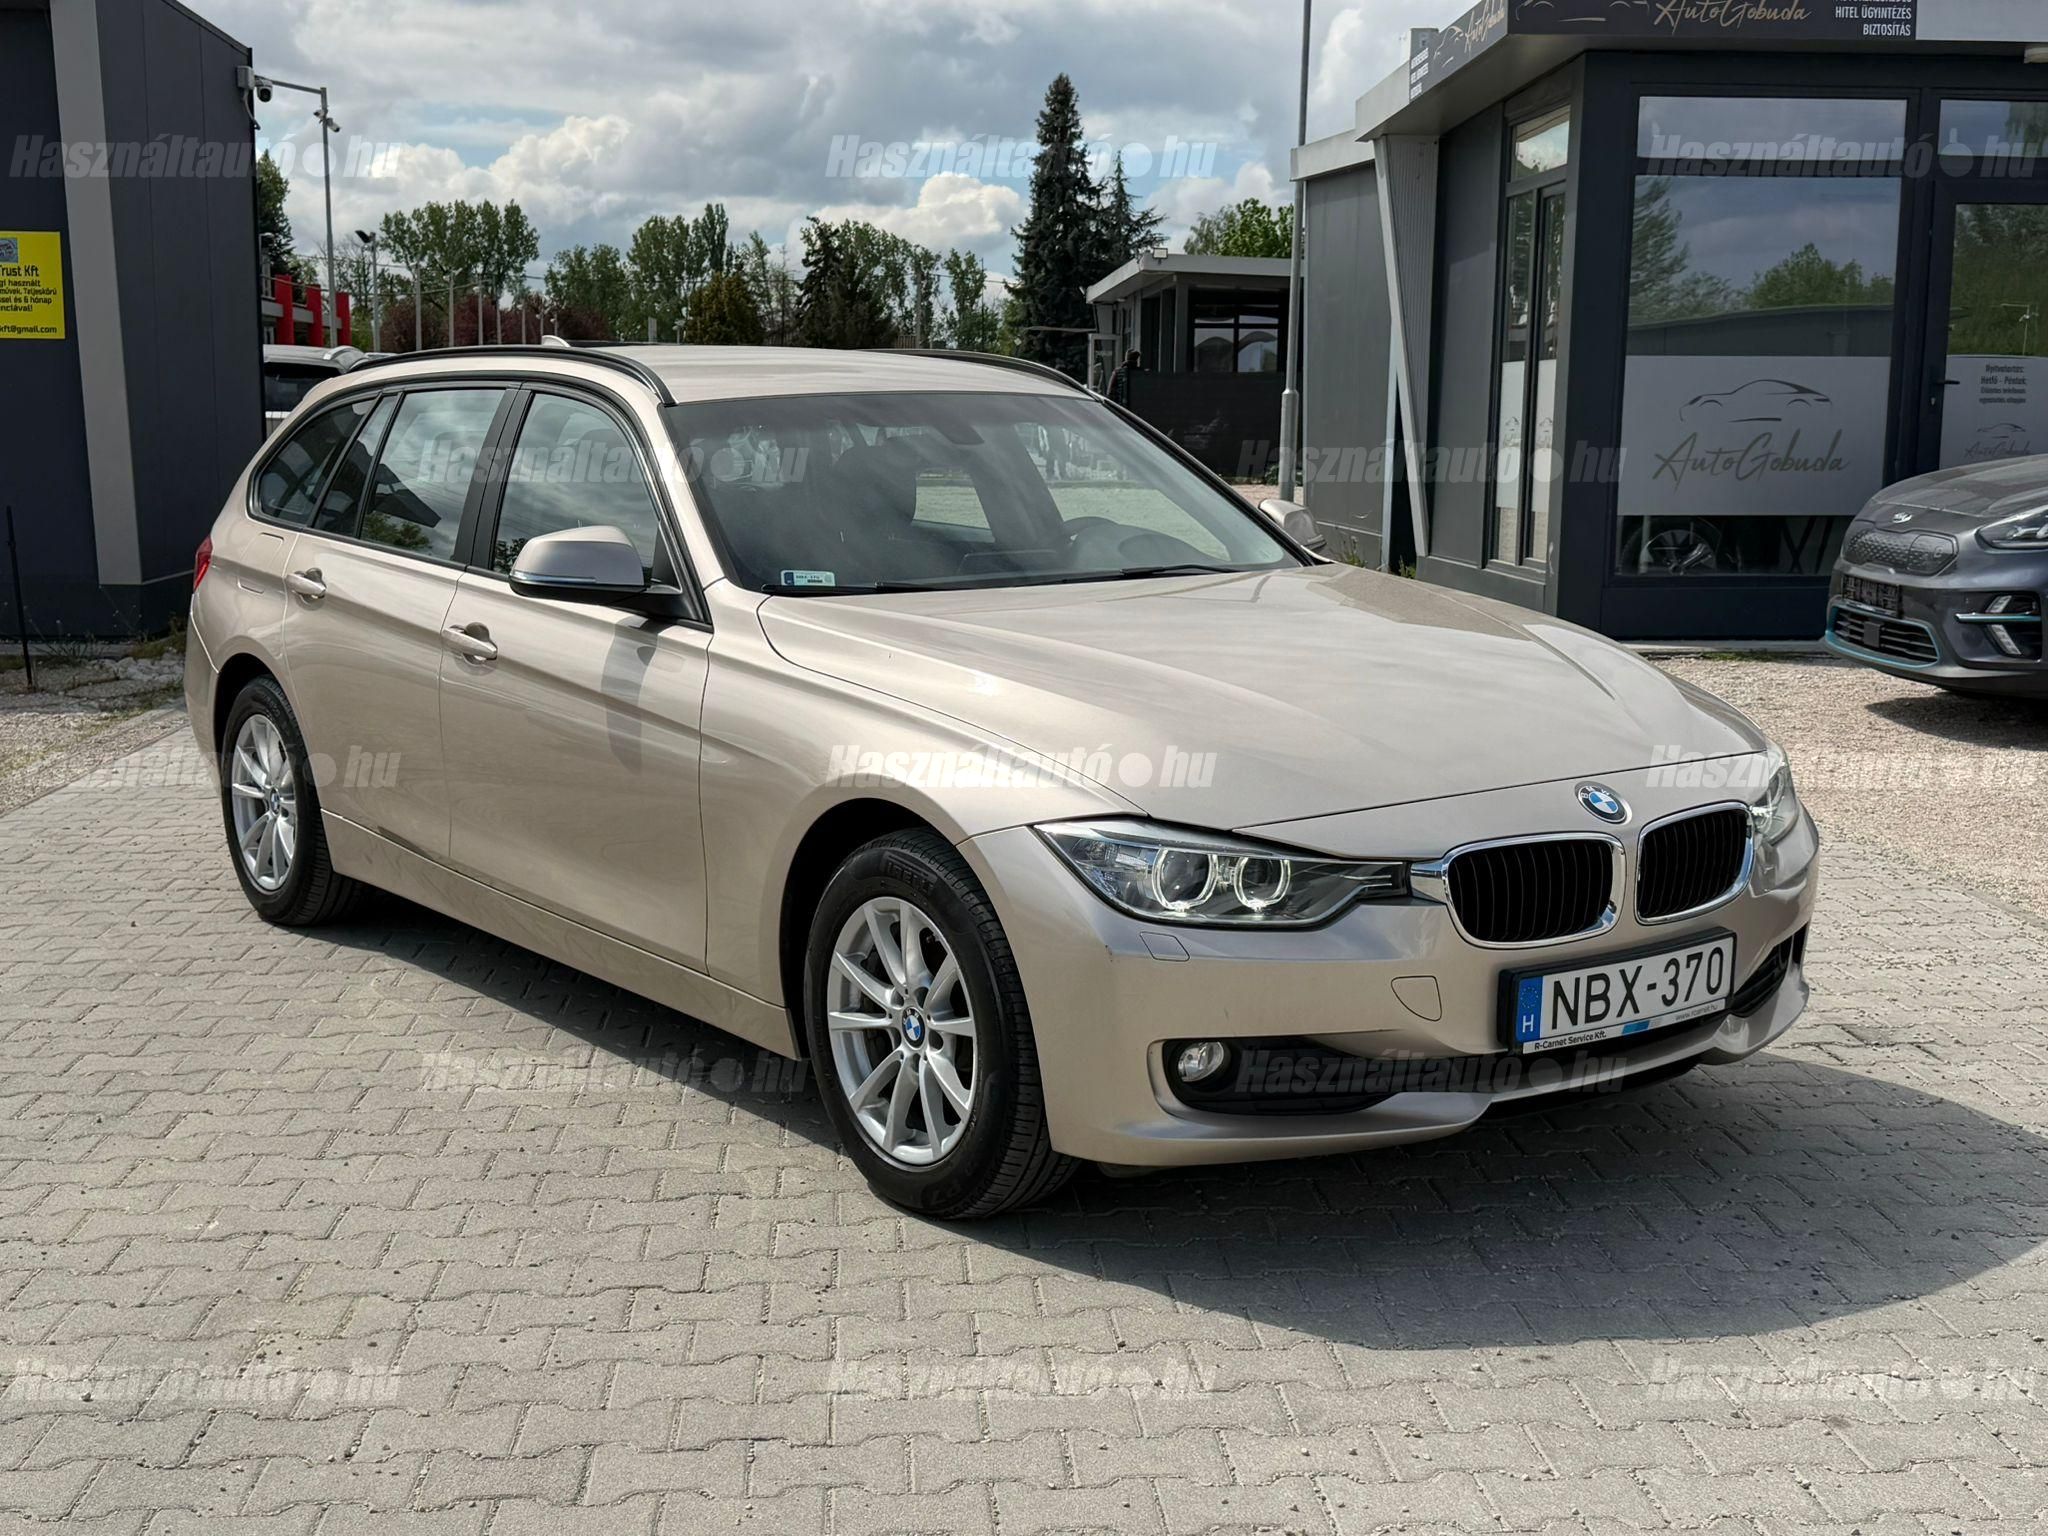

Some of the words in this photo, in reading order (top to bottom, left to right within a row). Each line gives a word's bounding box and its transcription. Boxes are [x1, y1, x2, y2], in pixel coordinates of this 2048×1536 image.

[1654, 0, 1812, 36] AutoGobuda
[1835, 6, 1859, 18] HITEL
[1861, 4, 1912, 20] ÜGYINTÉZÉS
[1863, 21, 1911, 36] BIZTOSÍTÁS
[24, 264, 39, 277] Kft
[8, 279, 41, 287] használt
[1652, 429, 1850, 493] AutoGobuda
[1551, 947, 1724, 1030] NBX-370
[1522, 1013, 1535, 1034] H
[1534, 1037, 1567, 1051] R-Carnet
[1568, 1033, 1594, 1044] Service
